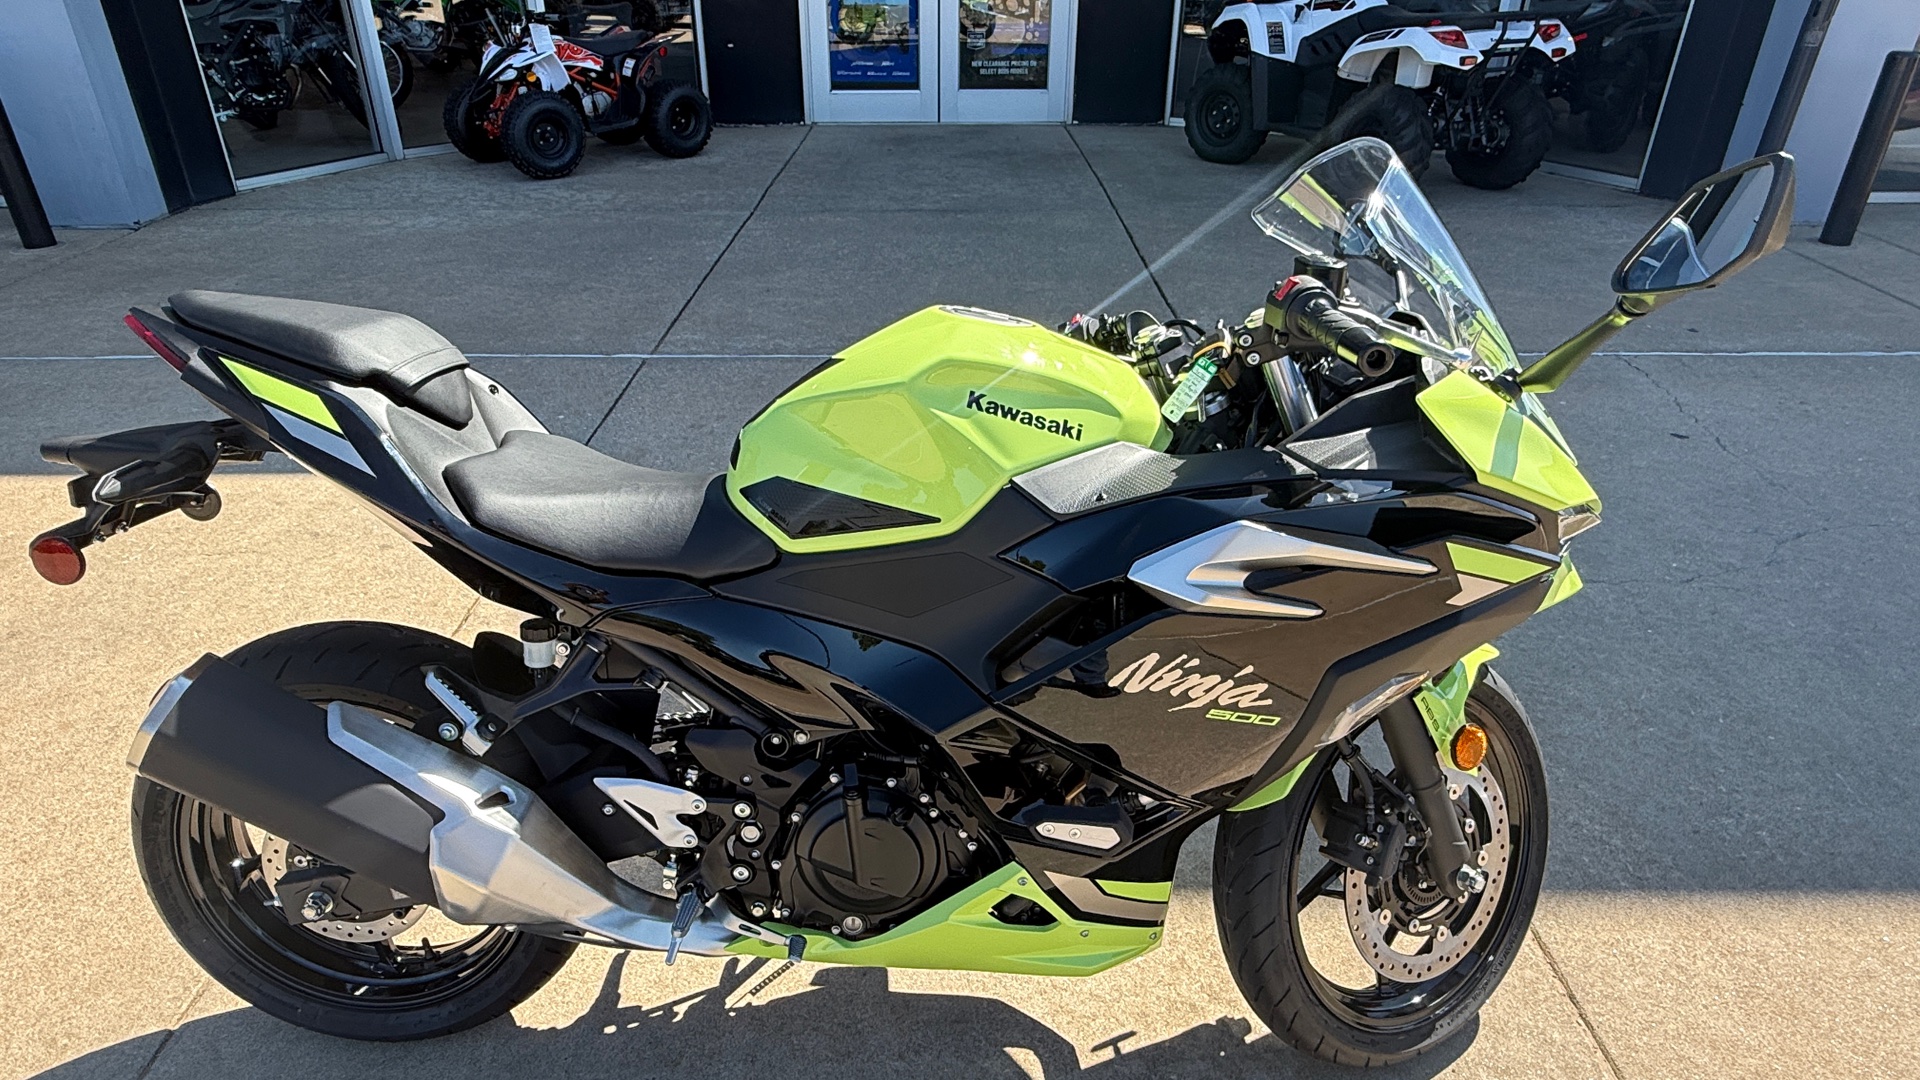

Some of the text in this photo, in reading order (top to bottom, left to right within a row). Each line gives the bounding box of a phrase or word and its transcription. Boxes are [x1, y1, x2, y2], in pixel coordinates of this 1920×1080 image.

[966, 390, 1084, 442] Kawasaki
[1108, 652, 1274, 713] Ninja
[1205, 708, 1282, 727] 500
[1420, 696, 1440, 732] ABS
